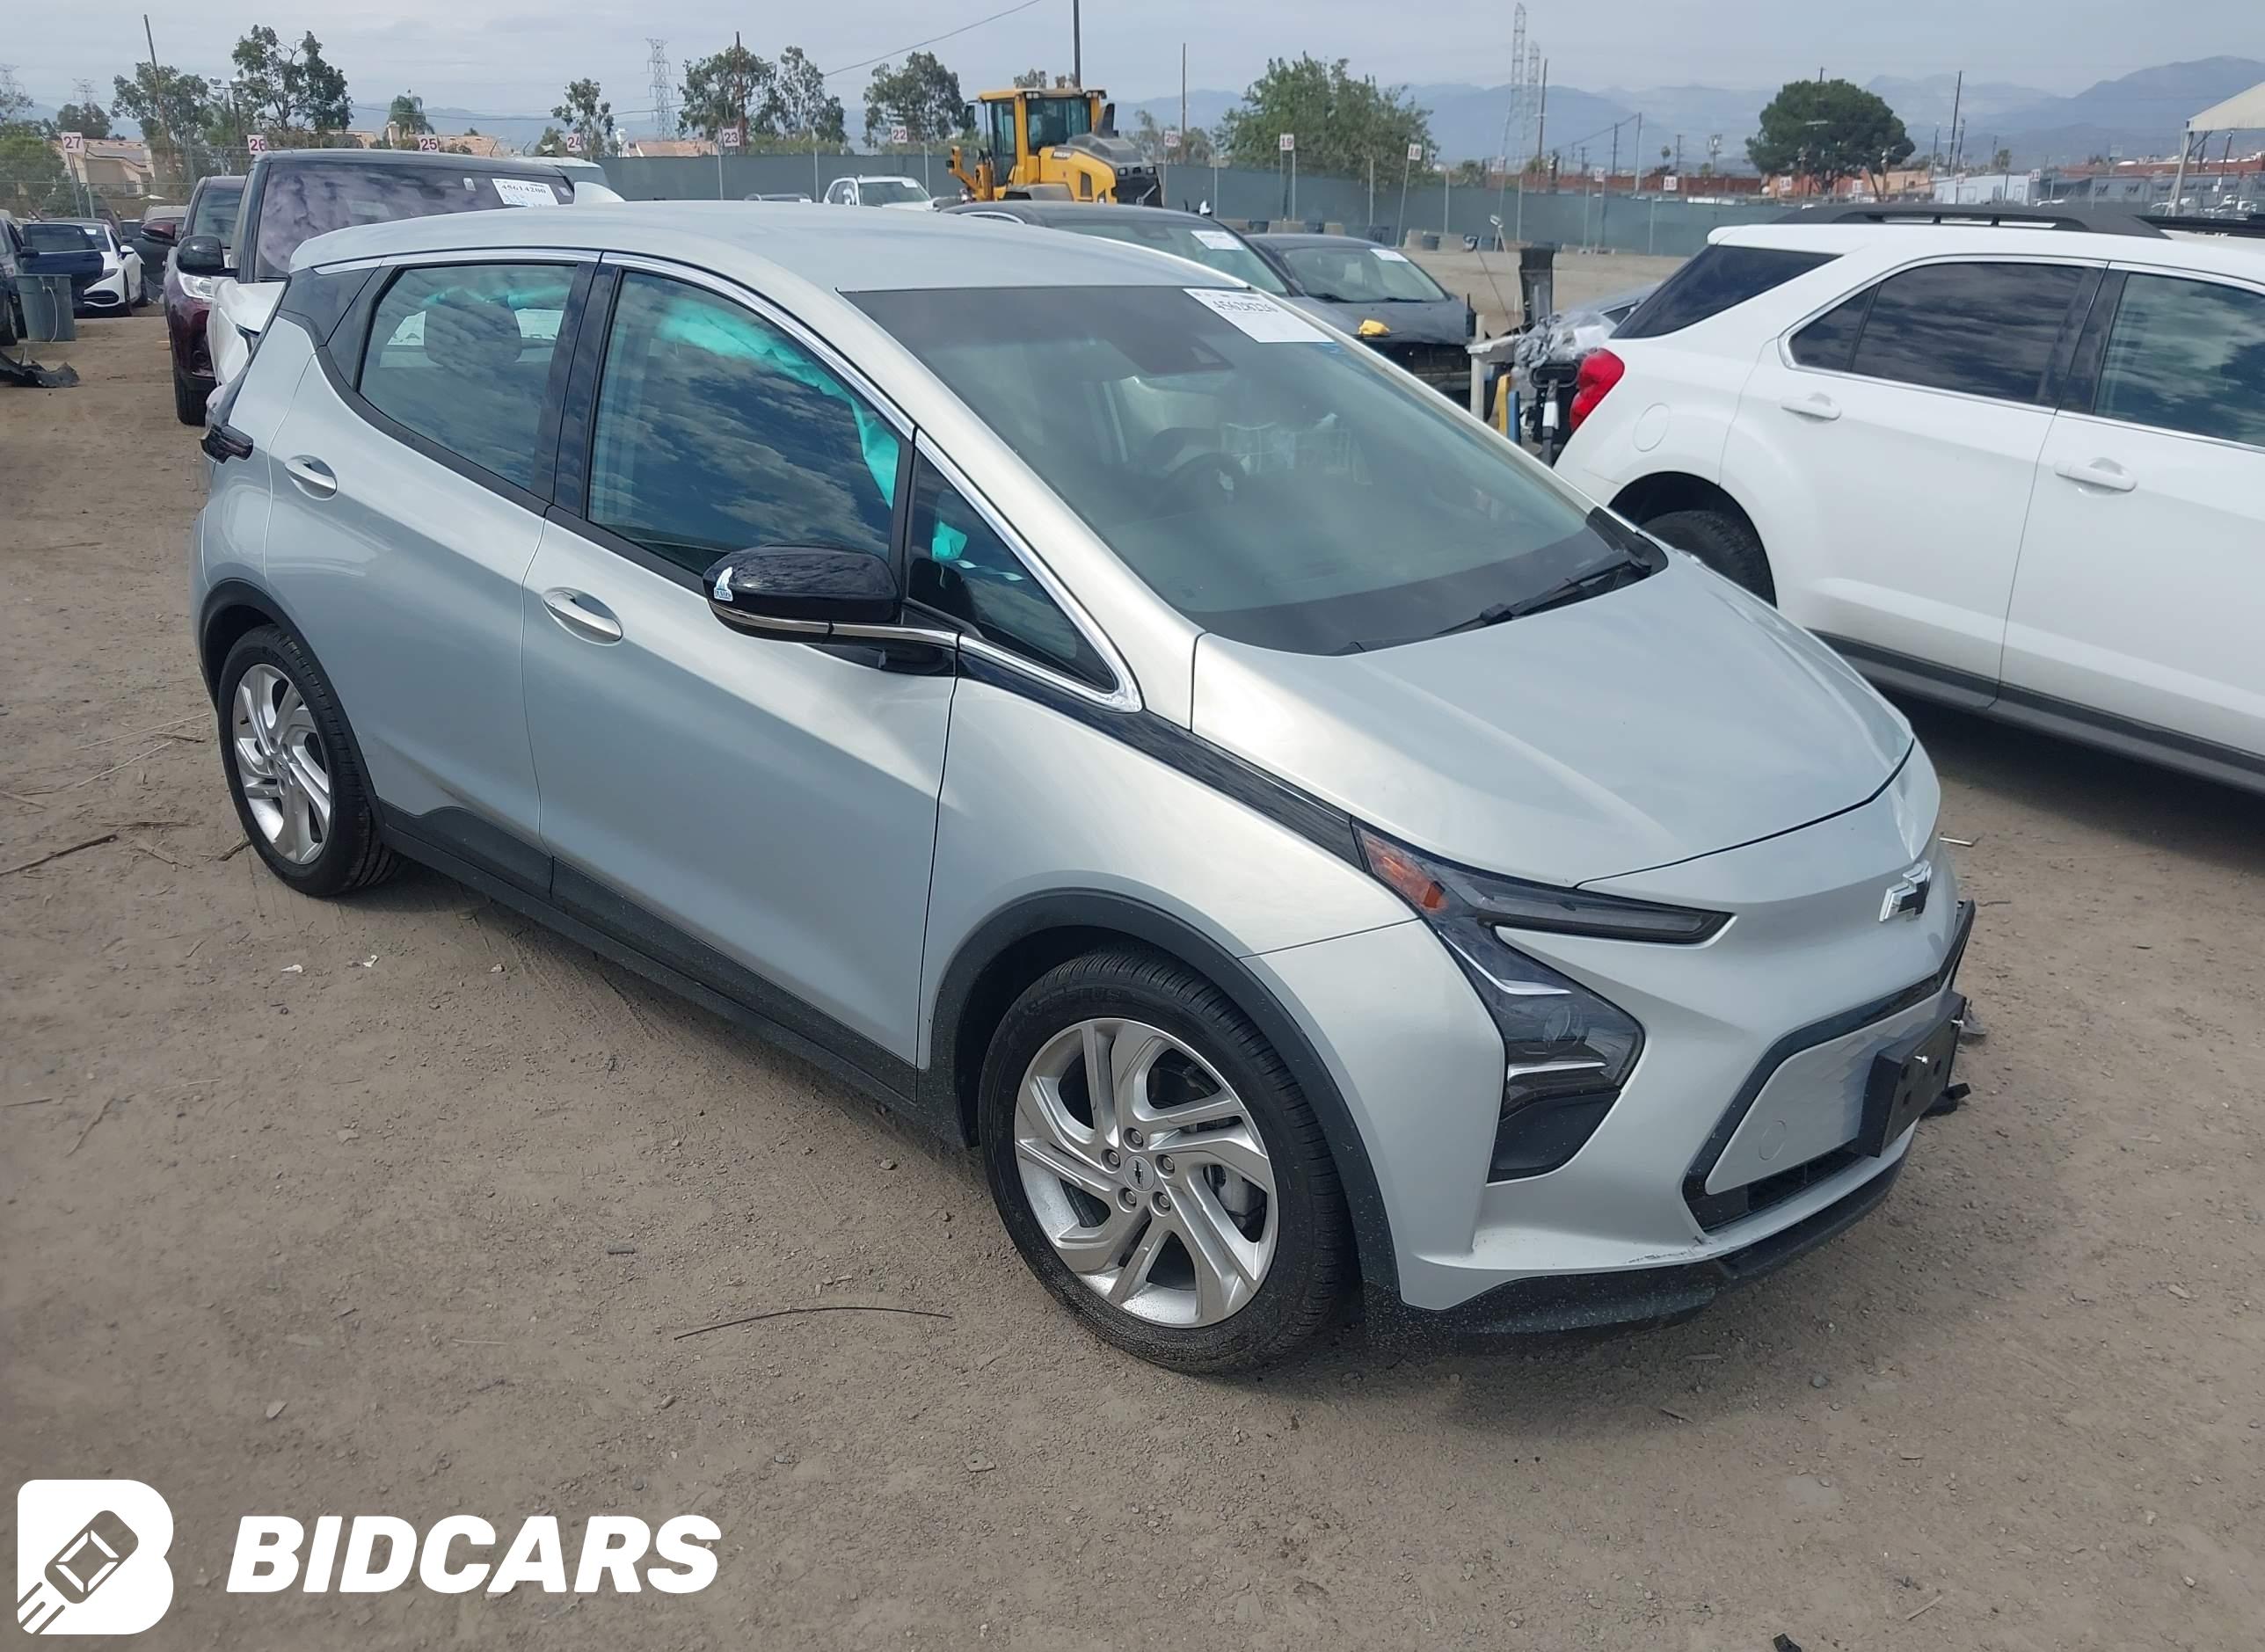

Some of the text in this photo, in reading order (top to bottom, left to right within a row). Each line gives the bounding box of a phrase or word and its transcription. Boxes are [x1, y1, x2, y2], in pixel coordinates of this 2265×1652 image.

[725, 132, 739, 143] 23
[892, 129, 907, 141] 22
[63, 136, 81, 149] 27
[249, 138, 266, 151] 26
[420, 138, 438, 150] 25
[567, 136, 581, 149] 24
[1281, 137, 1293, 148] 19
